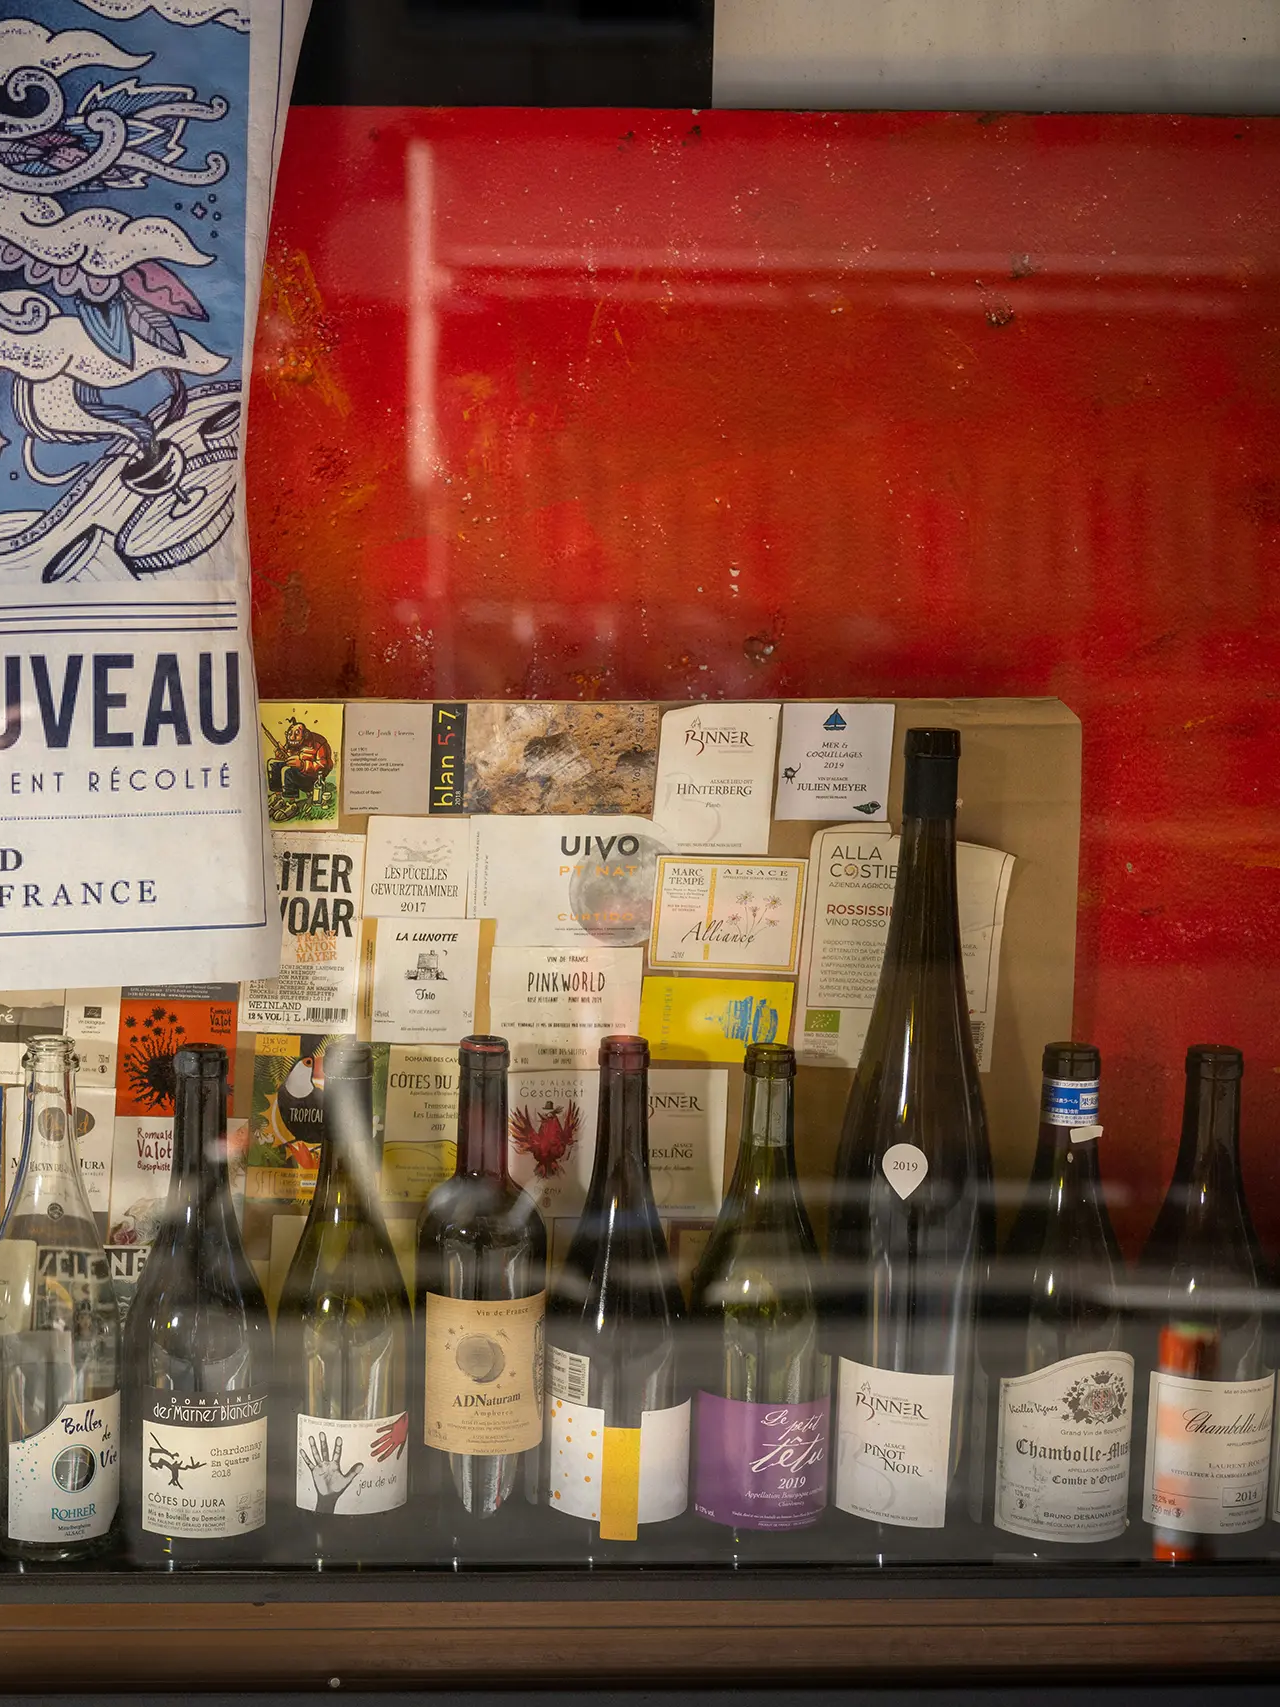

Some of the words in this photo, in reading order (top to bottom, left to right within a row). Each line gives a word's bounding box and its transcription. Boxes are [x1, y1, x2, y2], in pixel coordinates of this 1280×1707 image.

[684, 729, 756, 757] BINNER
[821, 741, 839, 749] MER
[806, 750, 863, 760] COQUILLAGES
[823, 761, 844, 769] 2019
[87, 763, 232, 792] RÉCOLTÉ
[434, 755, 454, 807] blan
[676, 783, 753, 797] HINTERBERG
[797, 783, 831, 792] JULIEN
[832, 783, 867, 793] MEYER
[560, 834, 640, 862] UIVO
[830, 845, 883, 861] ALLA
[384, 866, 401, 880] LES
[402, 866, 448, 881] PUCELLES
[559, 865, 585, 877] PT
[595, 865, 638, 877] NAT
[671, 867, 704, 878] MARC
[723, 868, 789, 877] ALSACE
[669, 875, 705, 886] TEMPÉ
[370, 882, 459, 898] GEWURZTRAMINER
[400, 902, 427, 913] 2017
[557, 912, 635, 922] CURTIDO
[825, 918, 849, 927] VINO
[852, 918, 887, 929] ROSSO
[295, 930, 337, 942] FRANZ
[395, 933, 409, 942] LA
[412, 932, 459, 942] LUNOTTE
[681, 919, 755, 943] Alliance
[295, 940, 337, 953] ANTON
[296, 950, 338, 963] MAYER
[568, 955, 589, 963] FRANCE
[415, 988, 436, 1001] Trio
[248, 1000, 302, 1011] WEINLAND
[210, 1015, 231, 1026] Valot
[265, 1012, 281, 1021] VOL
[276, 1037, 289, 1045] Vol
[390, 1071, 431, 1089] CÔTES
[435, 1075, 452, 1089] DU
[519, 1086, 585, 1098] Geschickt
[137, 1127, 172, 1140] Romuald
[137, 1139, 172, 1160] Valot
[136, 1160, 171, 1174] Biosophiste
[892, 1160, 919, 1173] 2019
[506, 1307, 529, 1316] France
[171, 1394, 252, 1405] DOMAINE
[153, 1402, 172, 1418] des
[173, 1404, 218, 1422] Marnes
[220, 1400, 263, 1421] Blanches
[855, 1391, 929, 1422] BINNER
[1009, 1403, 1034, 1414] Vieilles
[1034, 1402, 1059, 1416] Vignes
[61, 1409, 103, 1435] Bulles
[101, 1425, 112, 1442] de
[760, 1409, 788, 1427] Le
[778, 1411, 824, 1441] petit
[1060, 1428, 1081, 1436] Grand
[210, 1440, 263, 1457] Chardonnay
[748, 1433, 825, 1474] têtu
[864, 1442, 906, 1461] PINOT
[224, 1456, 251, 1467] Quatre
[879, 1456, 924, 1478] NOIR
[211, 1469, 232, 1478] 2018
[356, 1479, 372, 1496] jeu
[374, 1476, 386, 1487] de
[777, 1476, 807, 1490] 2019
[1052, 1475, 1088, 1486] Combe
[148, 1492, 178, 1506] CÔTES
[181, 1498, 197, 1508] DU
[200, 1498, 226, 1508] JURA
[1234, 1489, 1258, 1502] 2014
[51, 1503, 97, 1522] ROHRER
[1043, 1511, 1072, 1521] BRUNO
